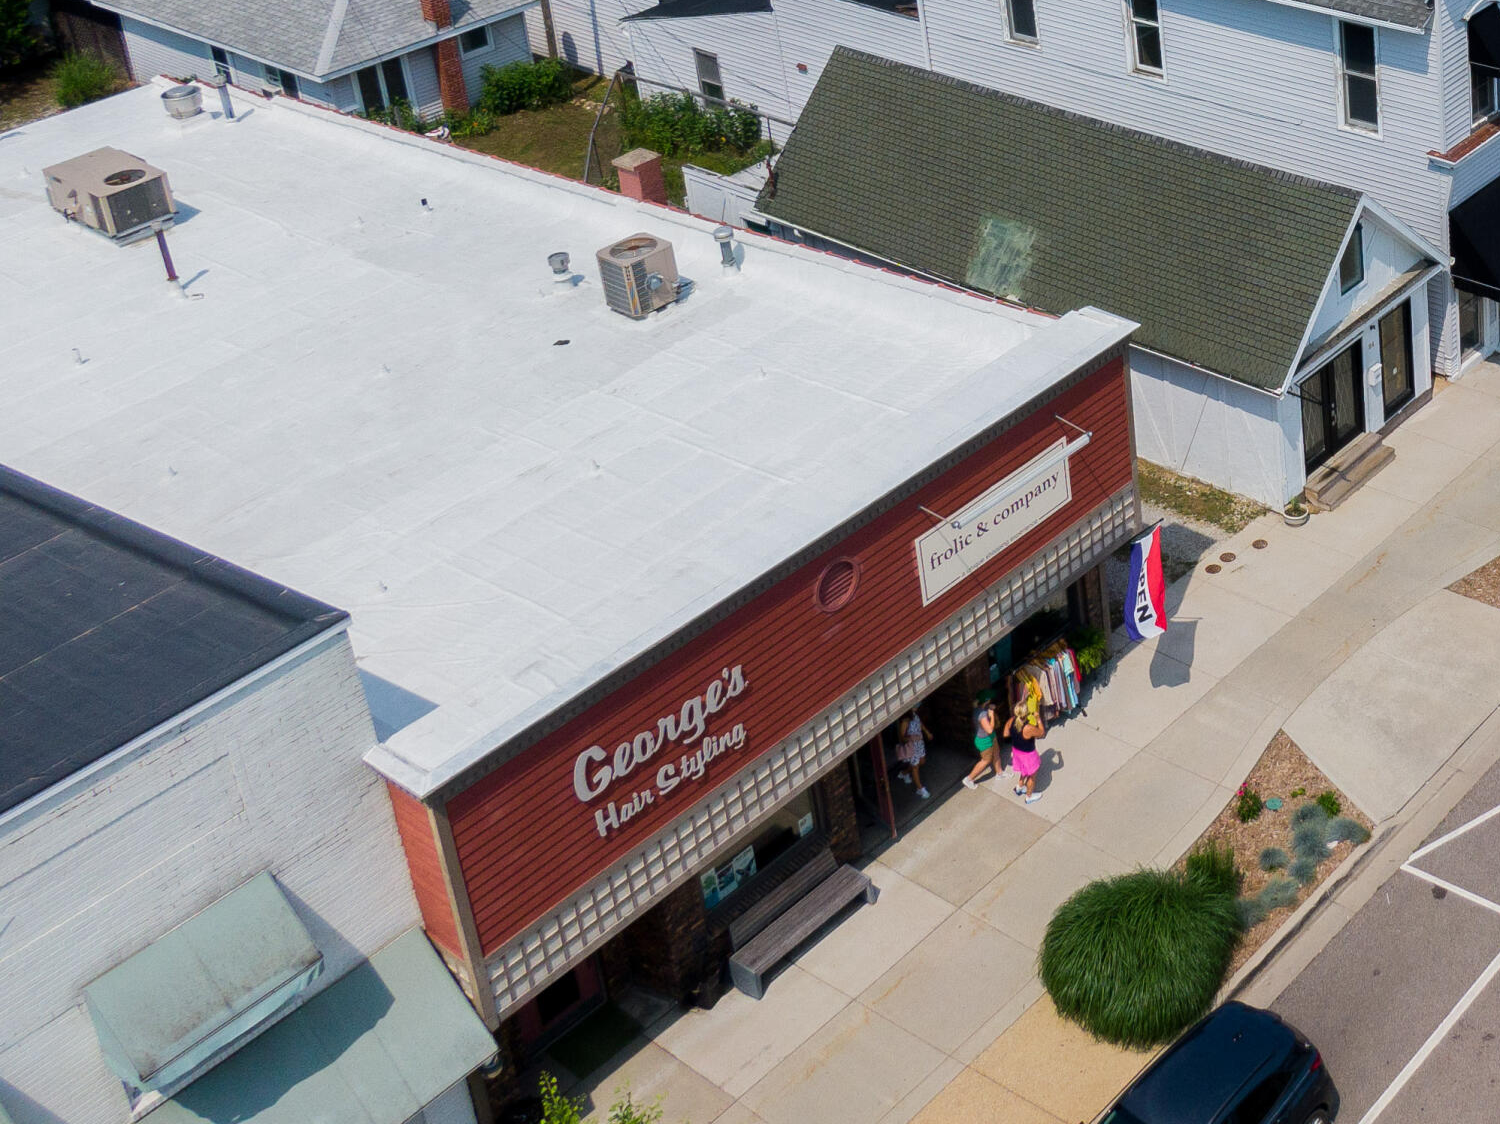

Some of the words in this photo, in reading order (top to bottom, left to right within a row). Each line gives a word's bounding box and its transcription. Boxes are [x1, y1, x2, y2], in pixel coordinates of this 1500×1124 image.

[929, 534, 973, 571] frolic
[976, 522, 990, 537] &
[993, 471, 1060, 527] company
[573, 664, 750, 802] George's
[594, 789, 655, 837] Hair
[656, 723, 747, 796] Styling
